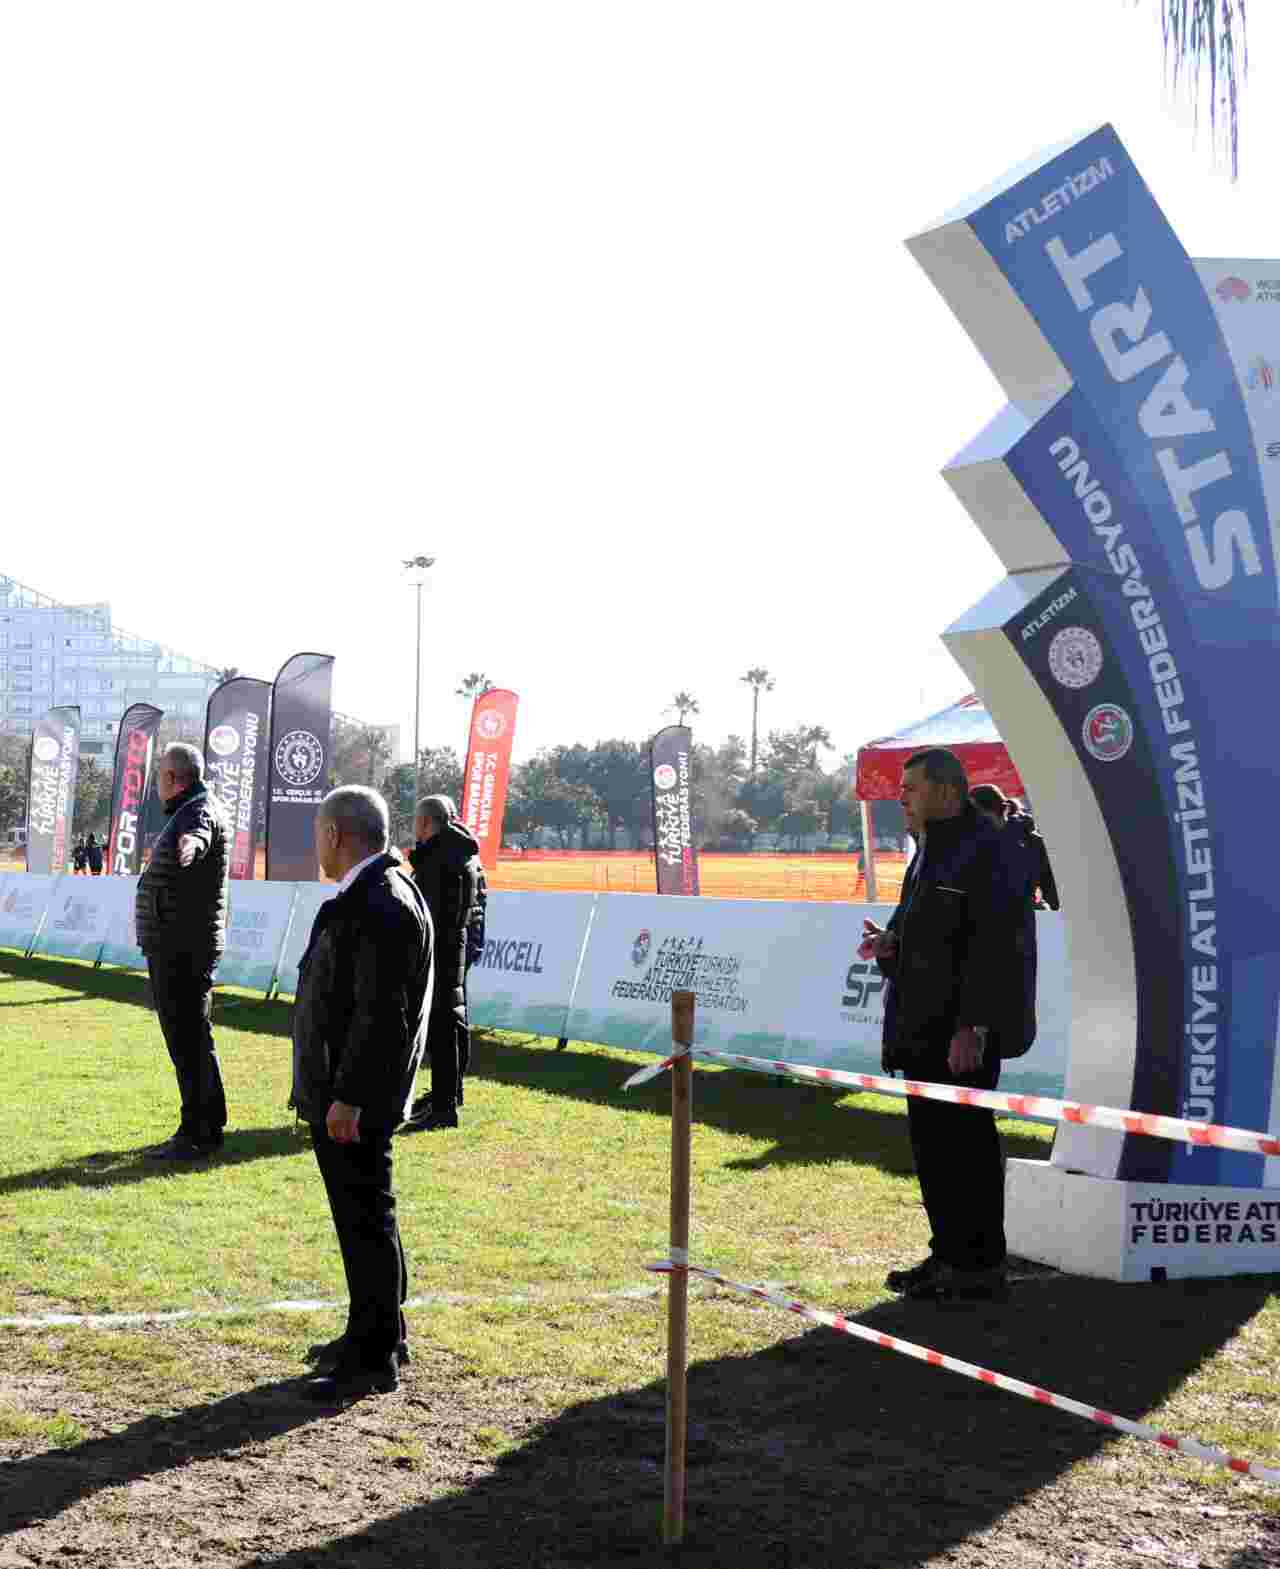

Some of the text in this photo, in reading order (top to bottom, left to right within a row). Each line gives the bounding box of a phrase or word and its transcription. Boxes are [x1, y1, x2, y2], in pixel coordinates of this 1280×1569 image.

[1006, 157, 1115, 244] ATLETİZM
[1045, 232, 1263, 589] START
[1020, 585, 1080, 641] ATLETİZM
[1048, 436, 1192, 736] FEDERASYONU
[114, 728, 151, 877] PORTOTO
[238, 712, 259, 831] FEDERASYONU
[1170, 741, 1217, 957] ATLETİZM
[477, 939, 544, 974] RKCELL
[1183, 965, 1218, 1156] ÜRKİYE
[1129, 1196, 1240, 1221] TÜRKİYE
